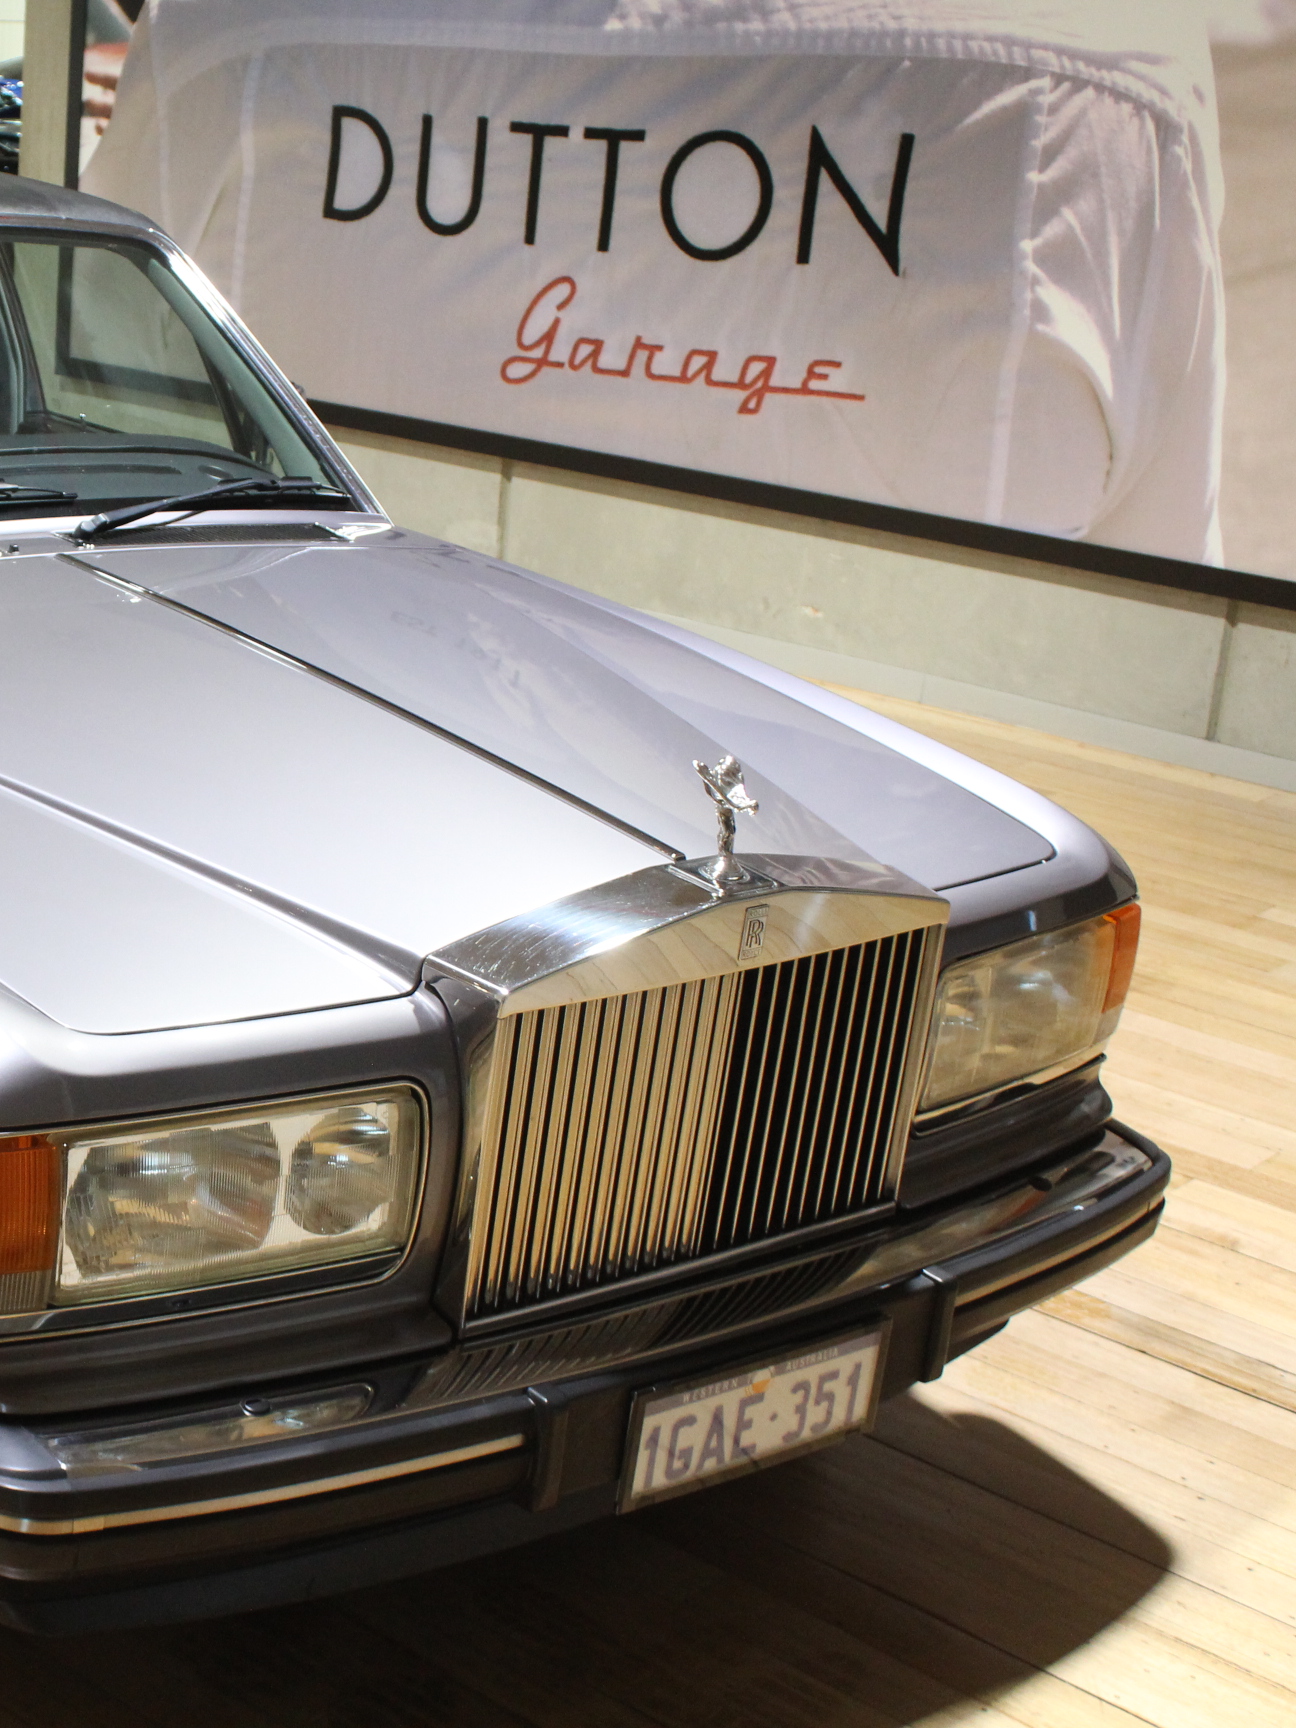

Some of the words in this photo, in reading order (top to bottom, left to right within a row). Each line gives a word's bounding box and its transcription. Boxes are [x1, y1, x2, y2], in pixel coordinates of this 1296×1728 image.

[323, 104, 916, 277] DUTTON
[500, 275, 866, 414] Garage
[682, 1377, 739, 1403] WESTERN
[785, 1347, 839, 1372] AUSTRALIA
